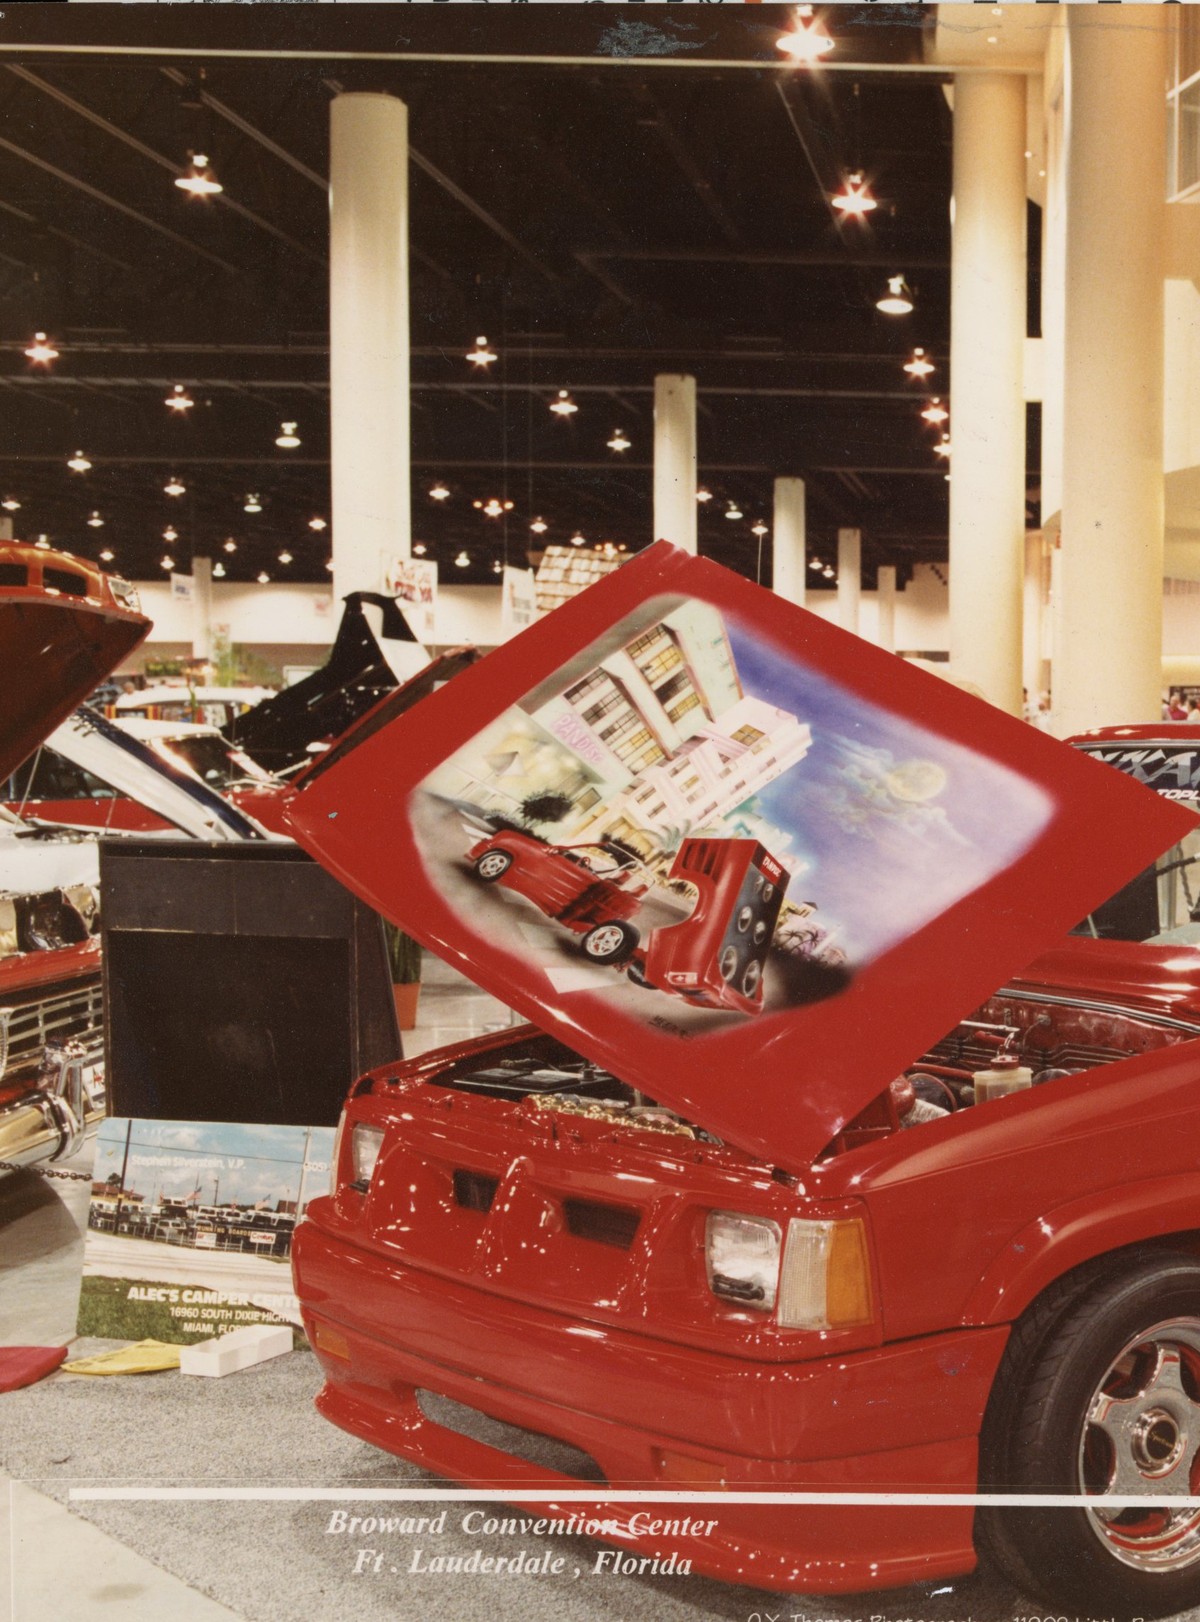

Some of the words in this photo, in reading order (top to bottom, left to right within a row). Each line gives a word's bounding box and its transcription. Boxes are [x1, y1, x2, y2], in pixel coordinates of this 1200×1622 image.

[127, 1286, 180, 1302] ALEC'S
[182, 1289, 249, 1305] CAMPER
[170, 1307, 199, 1318] 16960
[201, 1308, 233, 1320] SOUTH
[235, 1310, 260, 1321] DIXIE
